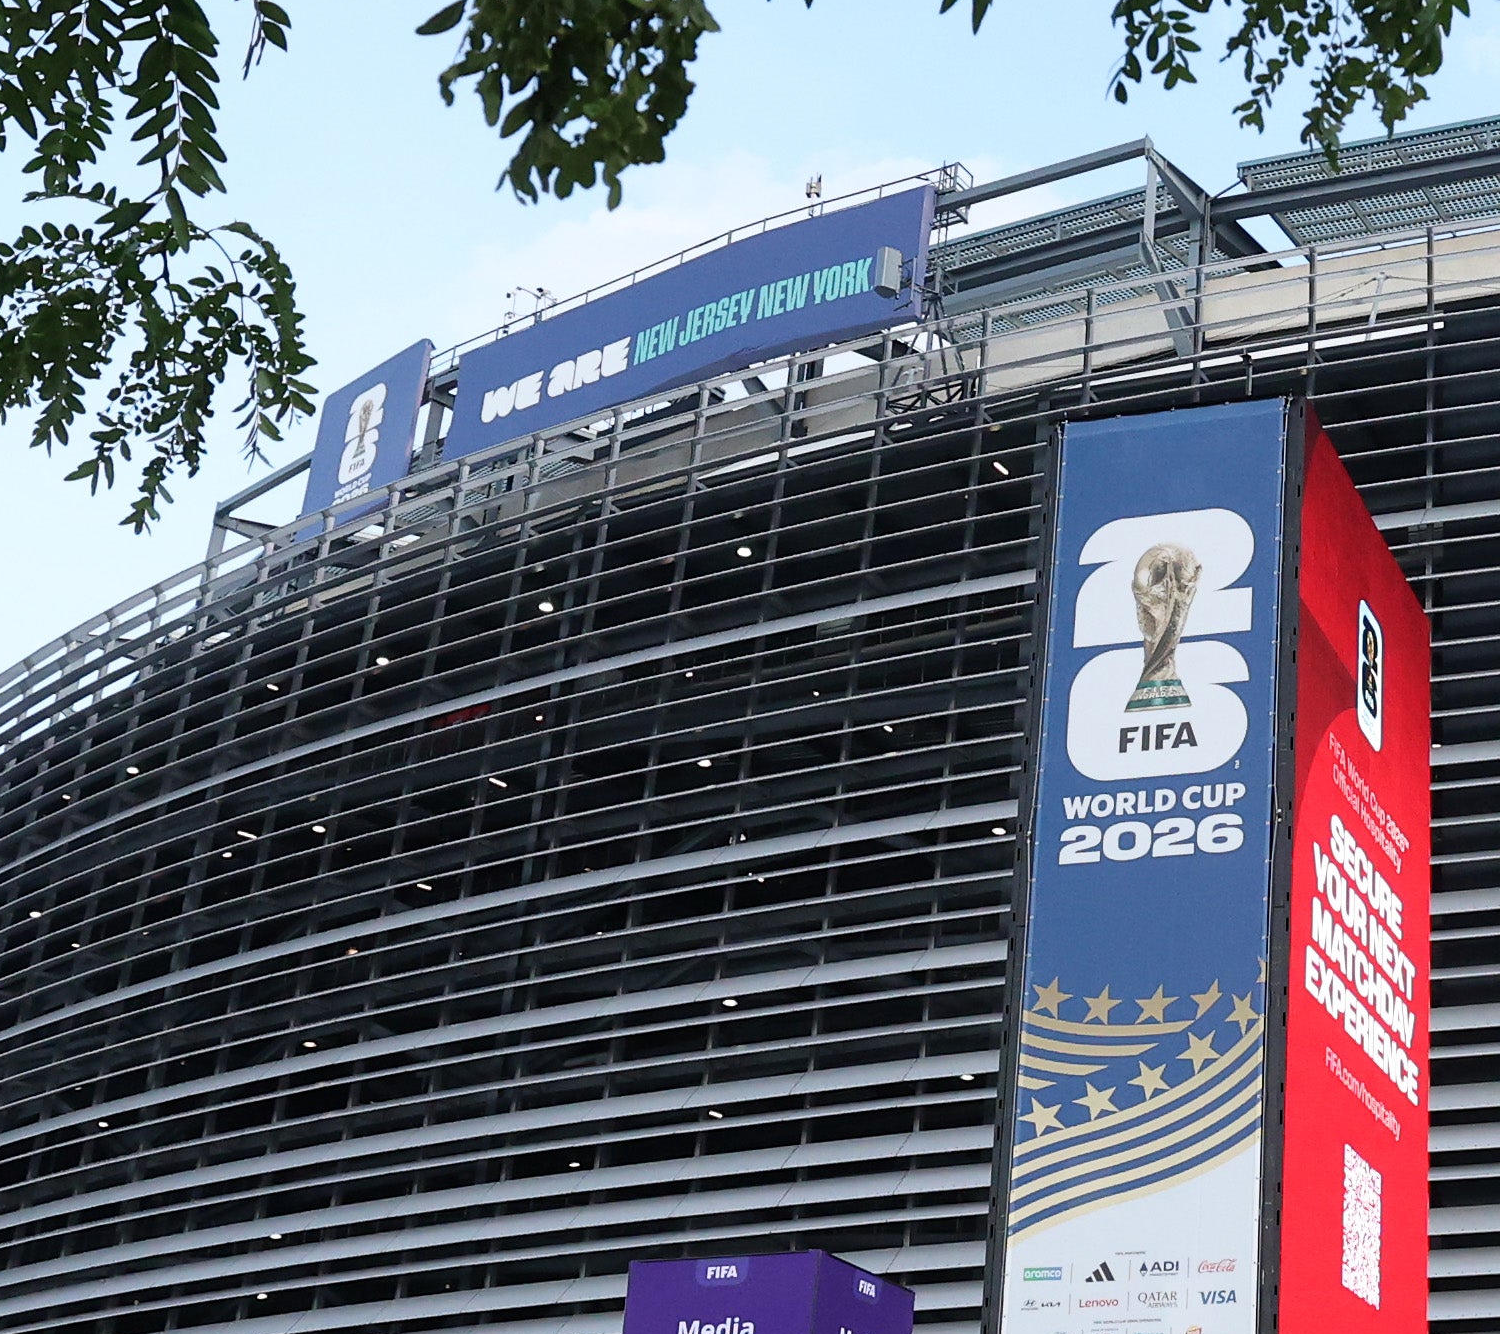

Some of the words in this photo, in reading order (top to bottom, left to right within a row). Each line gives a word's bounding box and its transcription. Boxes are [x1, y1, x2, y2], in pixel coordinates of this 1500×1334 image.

[481, 371, 543, 423] WE
[547, 337, 631, 397] ARE
[634, 316, 679, 365] NEW
[679, 289, 756, 346] JERSEY
[757, 273, 810, 320] NEW
[813, 257, 873, 304] YORK
[335, 478, 358, 498] WORLD
[358, 473, 372, 487] CUP
[349, 461, 365, 473] FIFA
[1119, 722, 1198, 753] FIFA
[1329, 732, 1346, 770] FIFA
[1347, 757, 1370, 800] World
[1063, 787, 1183, 820] WORLD
[1187, 782, 1246, 810] CUP
[1332, 765, 1361, 816] Official
[1361, 804, 1404, 875] Hospitality
[1058, 813, 1245, 865] 2026
[1330, 814, 1403, 941] SECURE
[1313, 841, 1368, 946] YOUR
[1370, 915, 1416, 1002] NEXT
[1312, 896, 1416, 1049] MATCHDAY
[1305, 945, 1419, 1107] EXPERIENCE
[1325, 1046, 1402, 1142] FIFA.com/hospitality
[706, 1265, 738, 1279] FIFA
[858, 1280, 876, 1298] FIFA
[1025, 1269, 1061, 1278] aramco
[1150, 1261, 1179, 1272] ADI
[1079, 1298, 1119, 1308] Lenovo
[1138, 1291, 1177, 1304] QATAR
[1200, 1289, 1237, 1305] VISA
